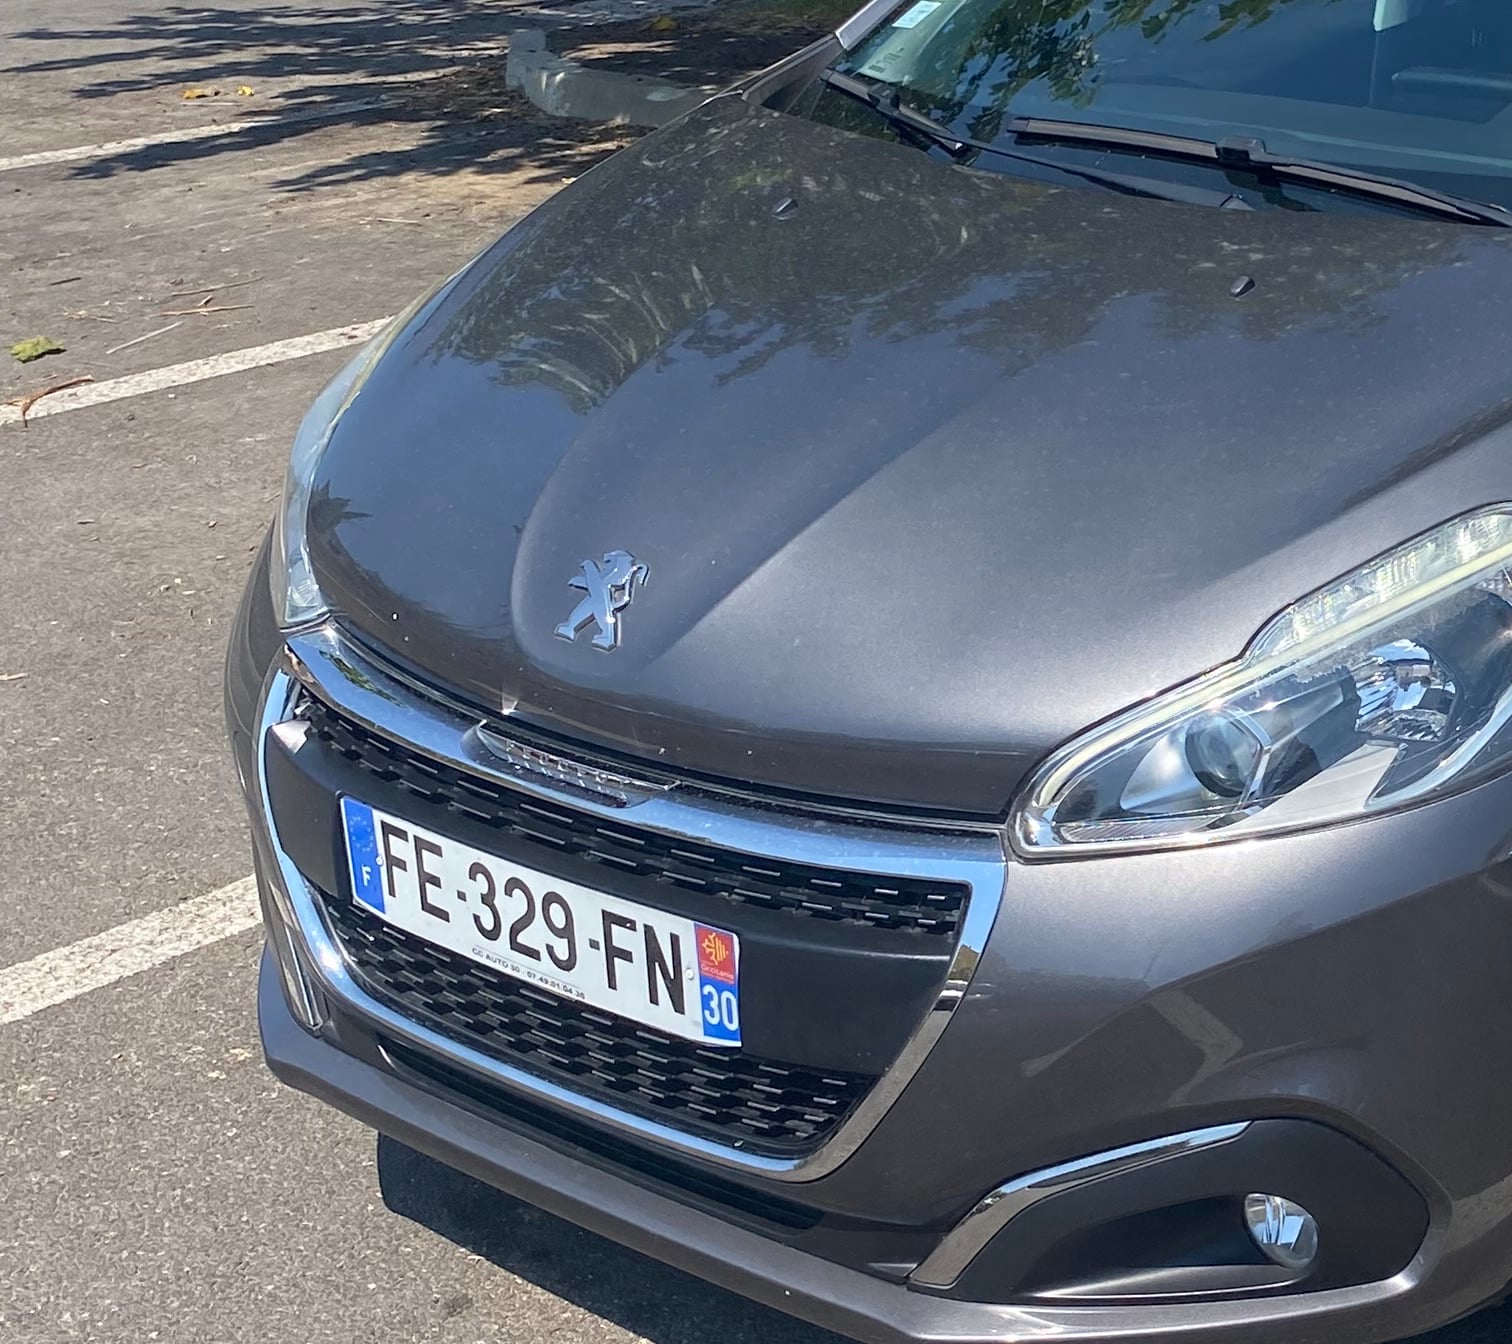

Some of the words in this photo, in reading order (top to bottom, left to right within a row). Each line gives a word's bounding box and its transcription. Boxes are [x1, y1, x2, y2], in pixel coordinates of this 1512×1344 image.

[360, 865, 373, 888] F
[381, 821, 685, 1015] FE-329-FN
[486, 955, 509, 968] AUTO
[703, 984, 739, 1032] 30
